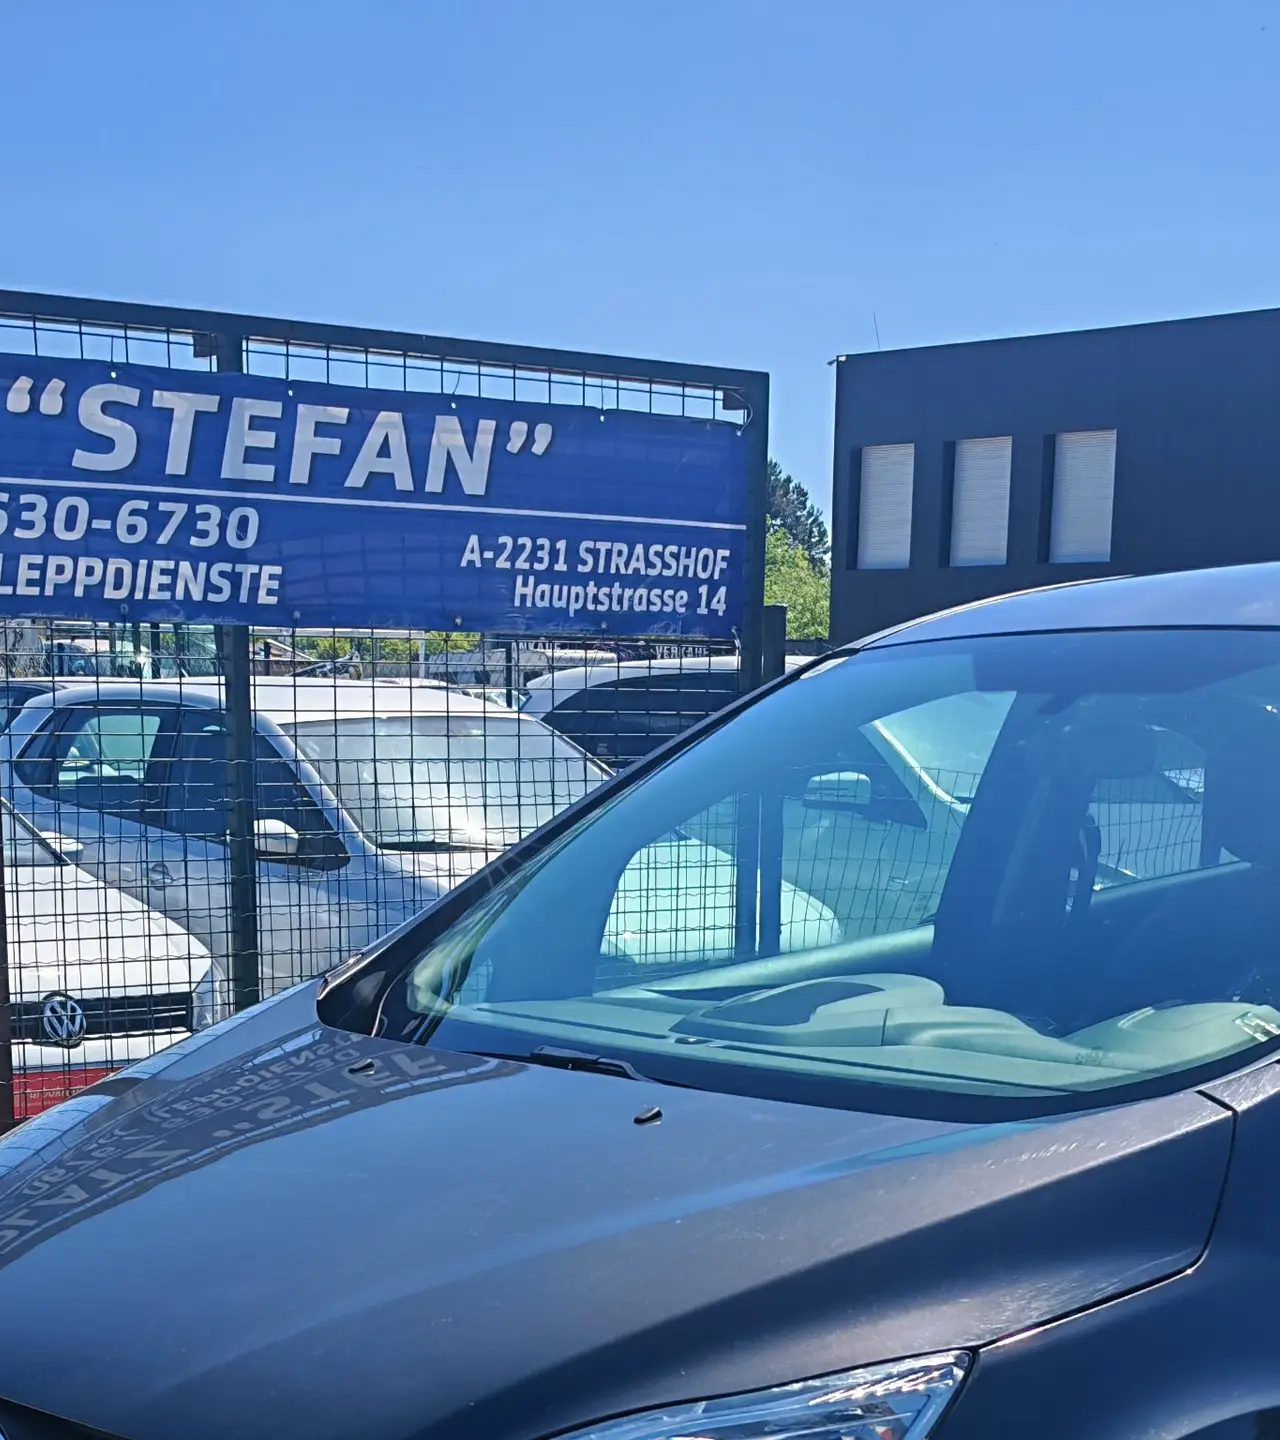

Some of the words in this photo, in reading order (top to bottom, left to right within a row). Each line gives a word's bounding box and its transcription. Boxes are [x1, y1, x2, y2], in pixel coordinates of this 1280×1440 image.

[460, 534, 568, 571] A-2231
[577, 540, 731, 580] STRASSHOF
[513, 575, 689, 617] Hauptstrasse
[697, 585, 728, 616] 14
